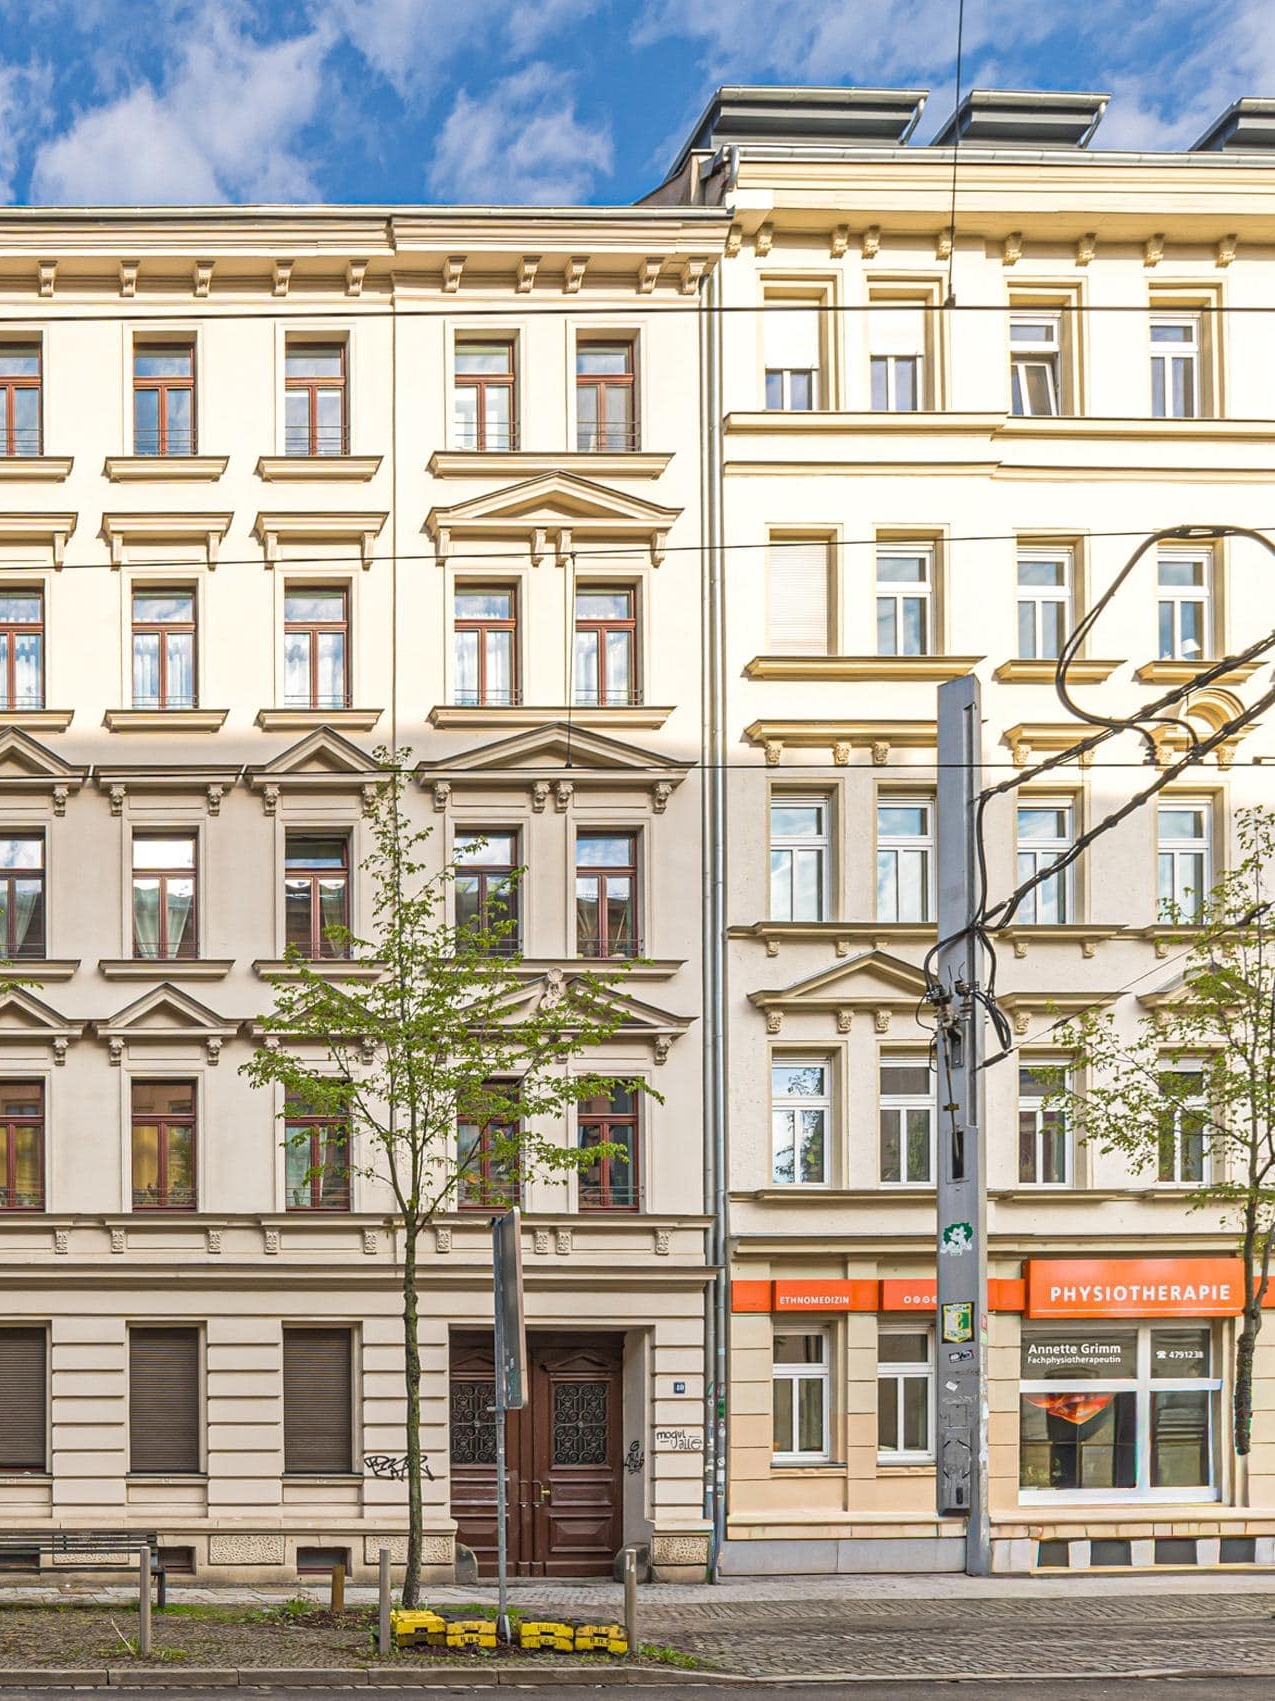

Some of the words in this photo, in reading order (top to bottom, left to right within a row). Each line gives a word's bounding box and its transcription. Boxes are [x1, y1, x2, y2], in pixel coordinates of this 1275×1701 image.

[1050, 1285, 1231, 1302] PHYSIOTHERAPIE
[779, 1295, 850, 1305] ETHNOMEDIZIN
[1028, 1343, 1078, 1354] Annette
[1080, 1343, 1121, 1354] Grimm
[1027, 1355, 1121, 1365] Fachphysiotherapeutin
